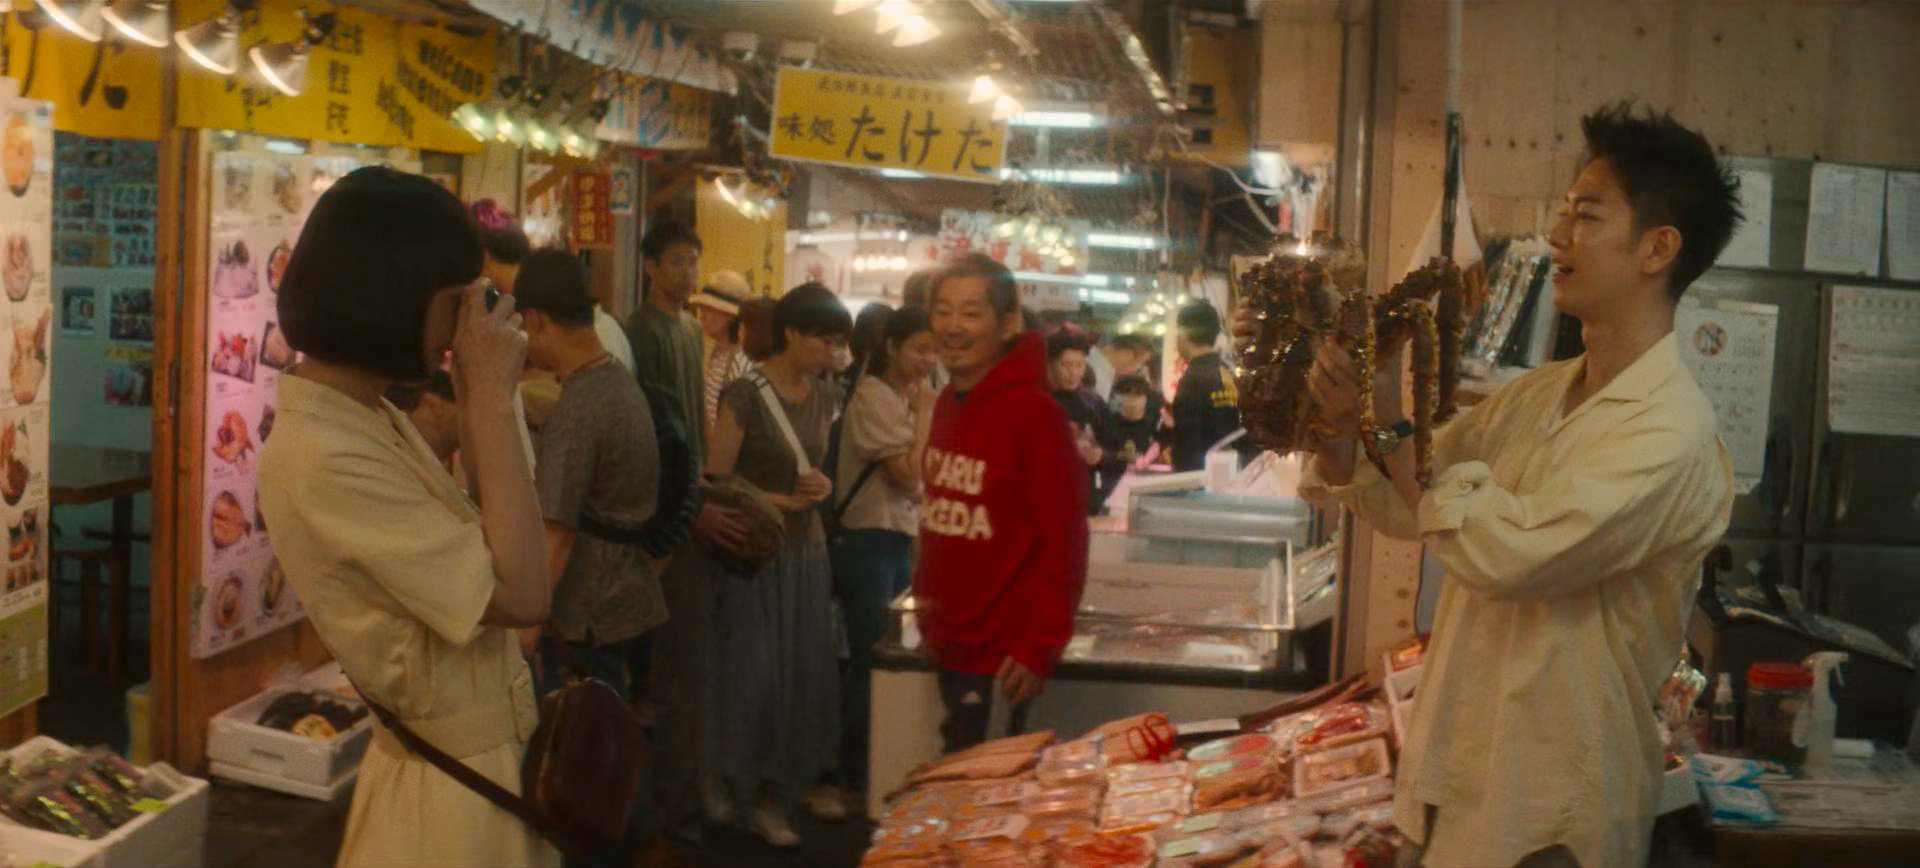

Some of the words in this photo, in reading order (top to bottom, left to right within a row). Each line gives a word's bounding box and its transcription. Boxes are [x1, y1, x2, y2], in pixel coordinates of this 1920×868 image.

[778, 111, 836, 146] 味処
[844, 104, 995, 172] たけだ
